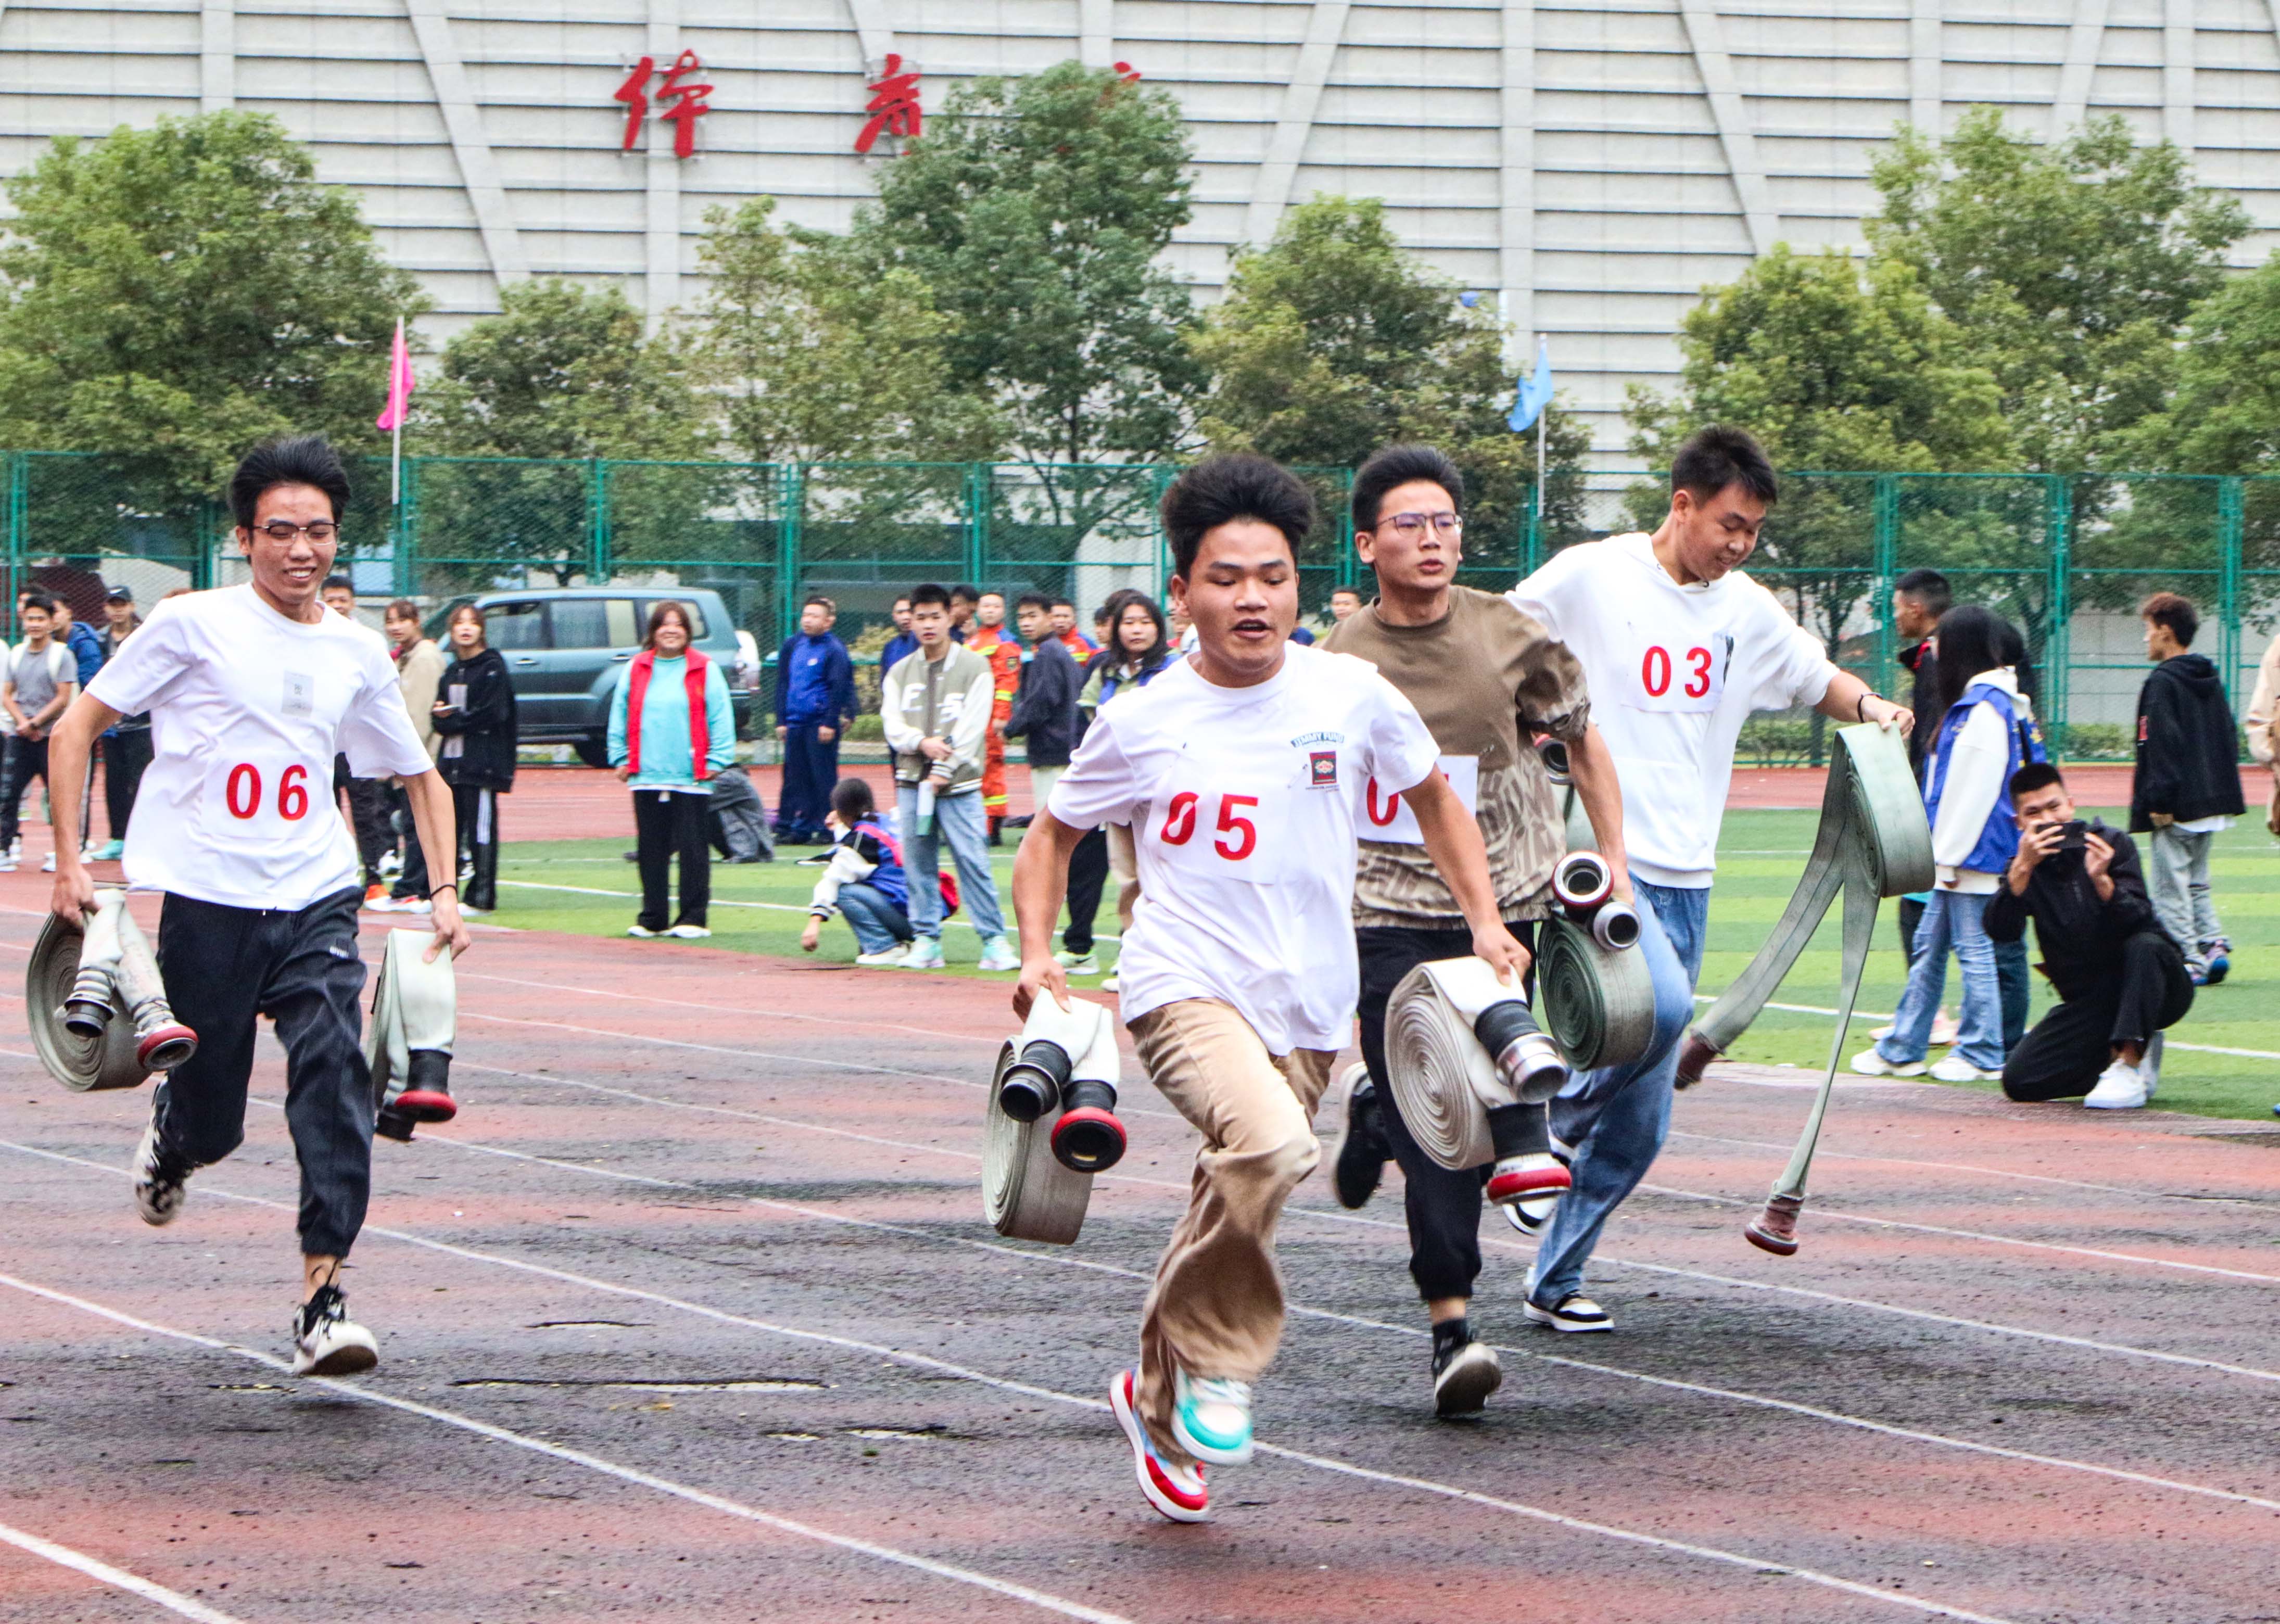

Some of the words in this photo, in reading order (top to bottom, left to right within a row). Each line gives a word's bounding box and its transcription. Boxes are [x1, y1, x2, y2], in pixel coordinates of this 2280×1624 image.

[1642, 645, 1712, 698] 03
[226, 763, 309, 821] 06
[1160, 791, 1259, 860] 05
